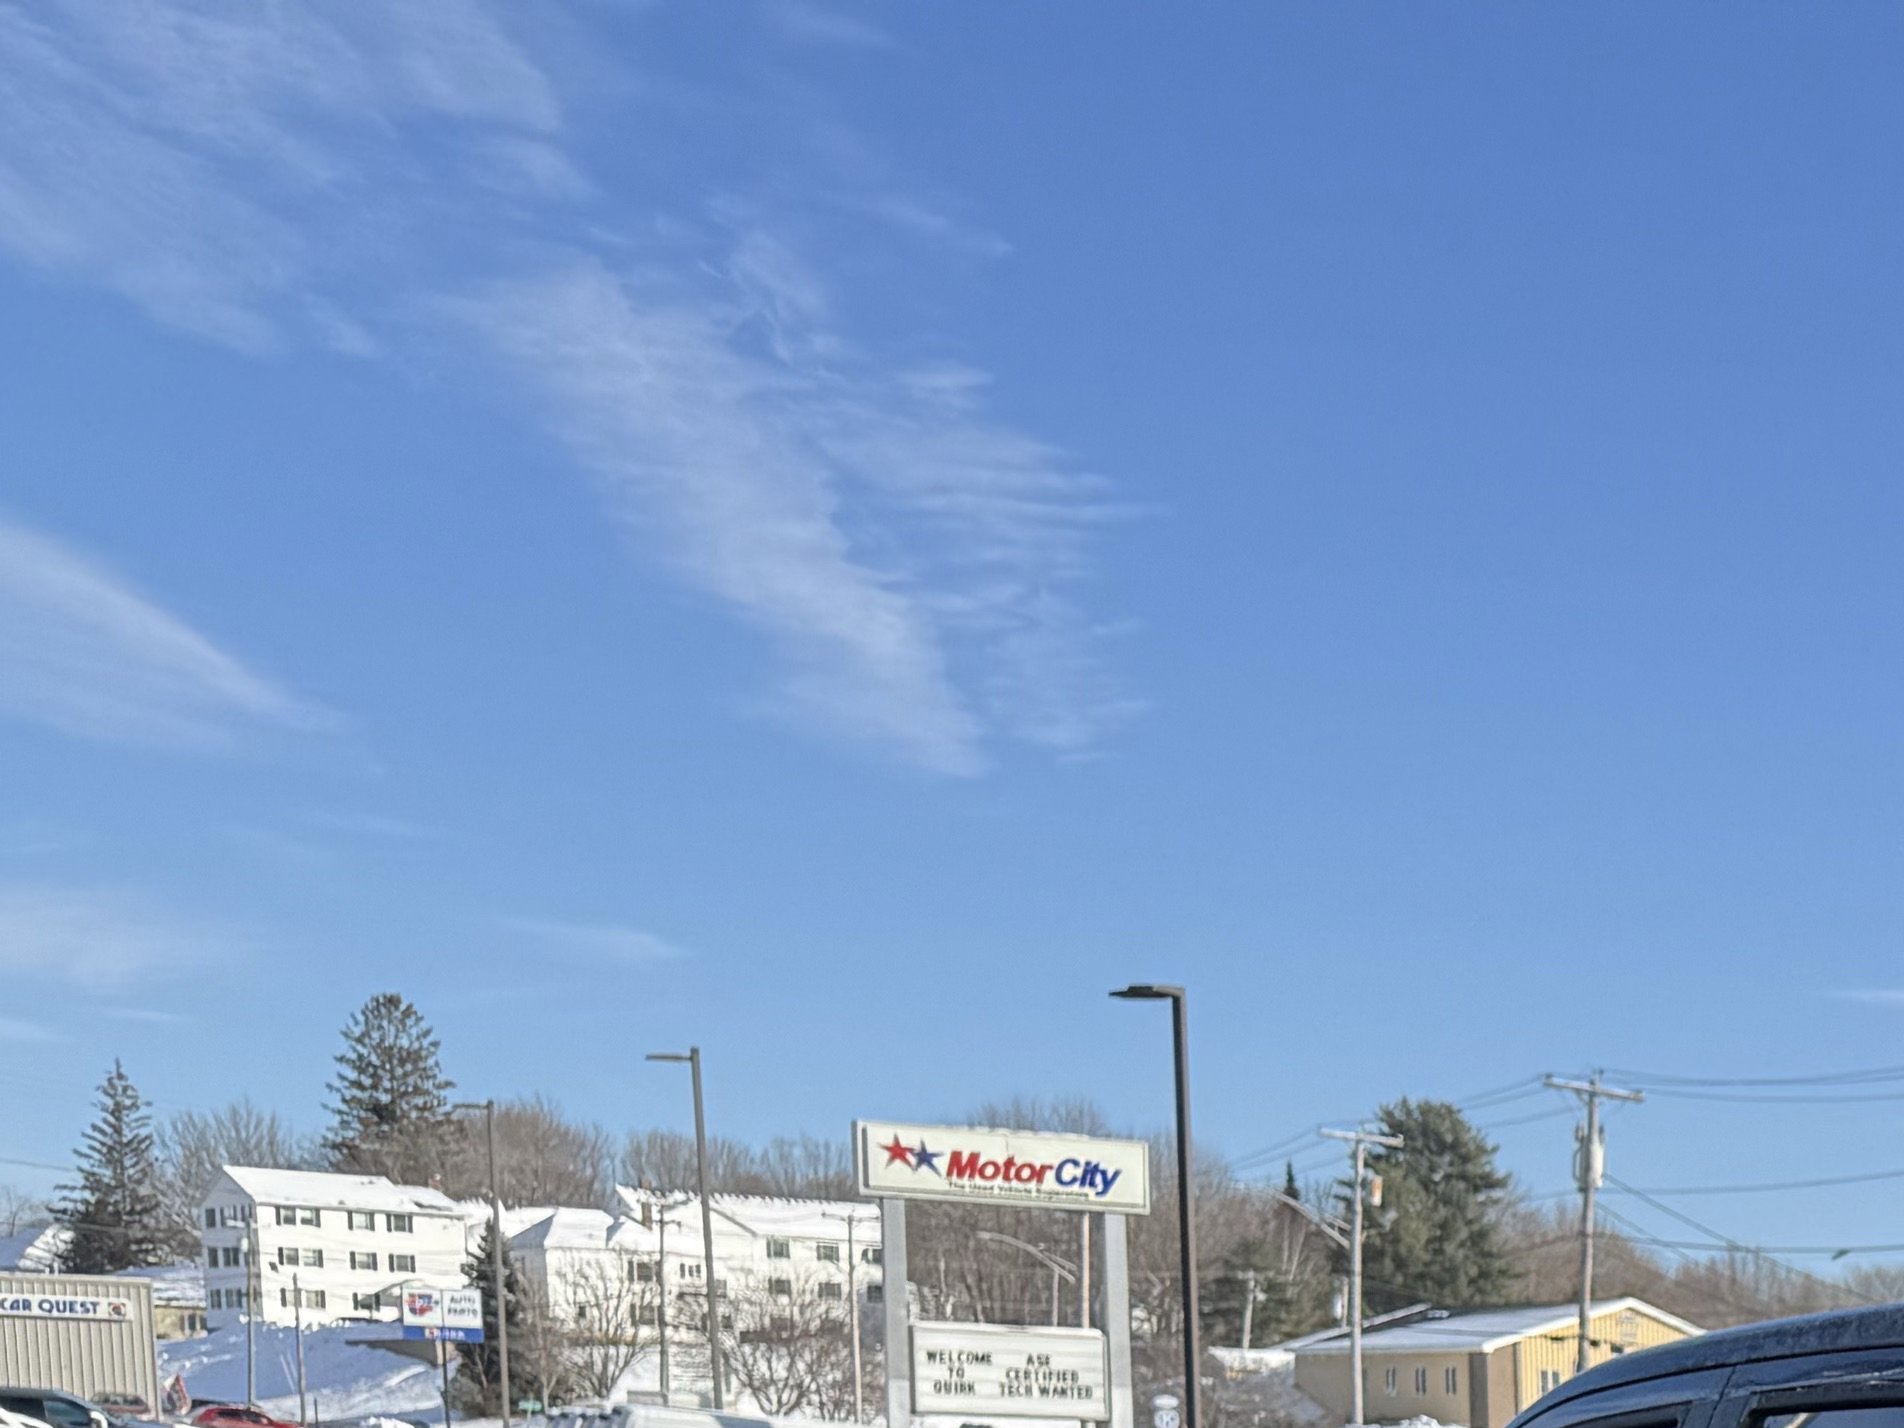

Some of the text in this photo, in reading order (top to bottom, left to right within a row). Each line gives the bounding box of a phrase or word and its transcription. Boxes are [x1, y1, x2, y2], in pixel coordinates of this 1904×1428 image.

[945, 1150, 1121, 1197] MotorCity
[38, 1299, 100, 1315] QUEST
[926, 1350, 993, 1366] WELCOME
[949, 1367, 965, 1379] TO
[1005, 1368, 1080, 1384] CERTIFIED
[1000, 1383, 1093, 1400] TECH WANTED
